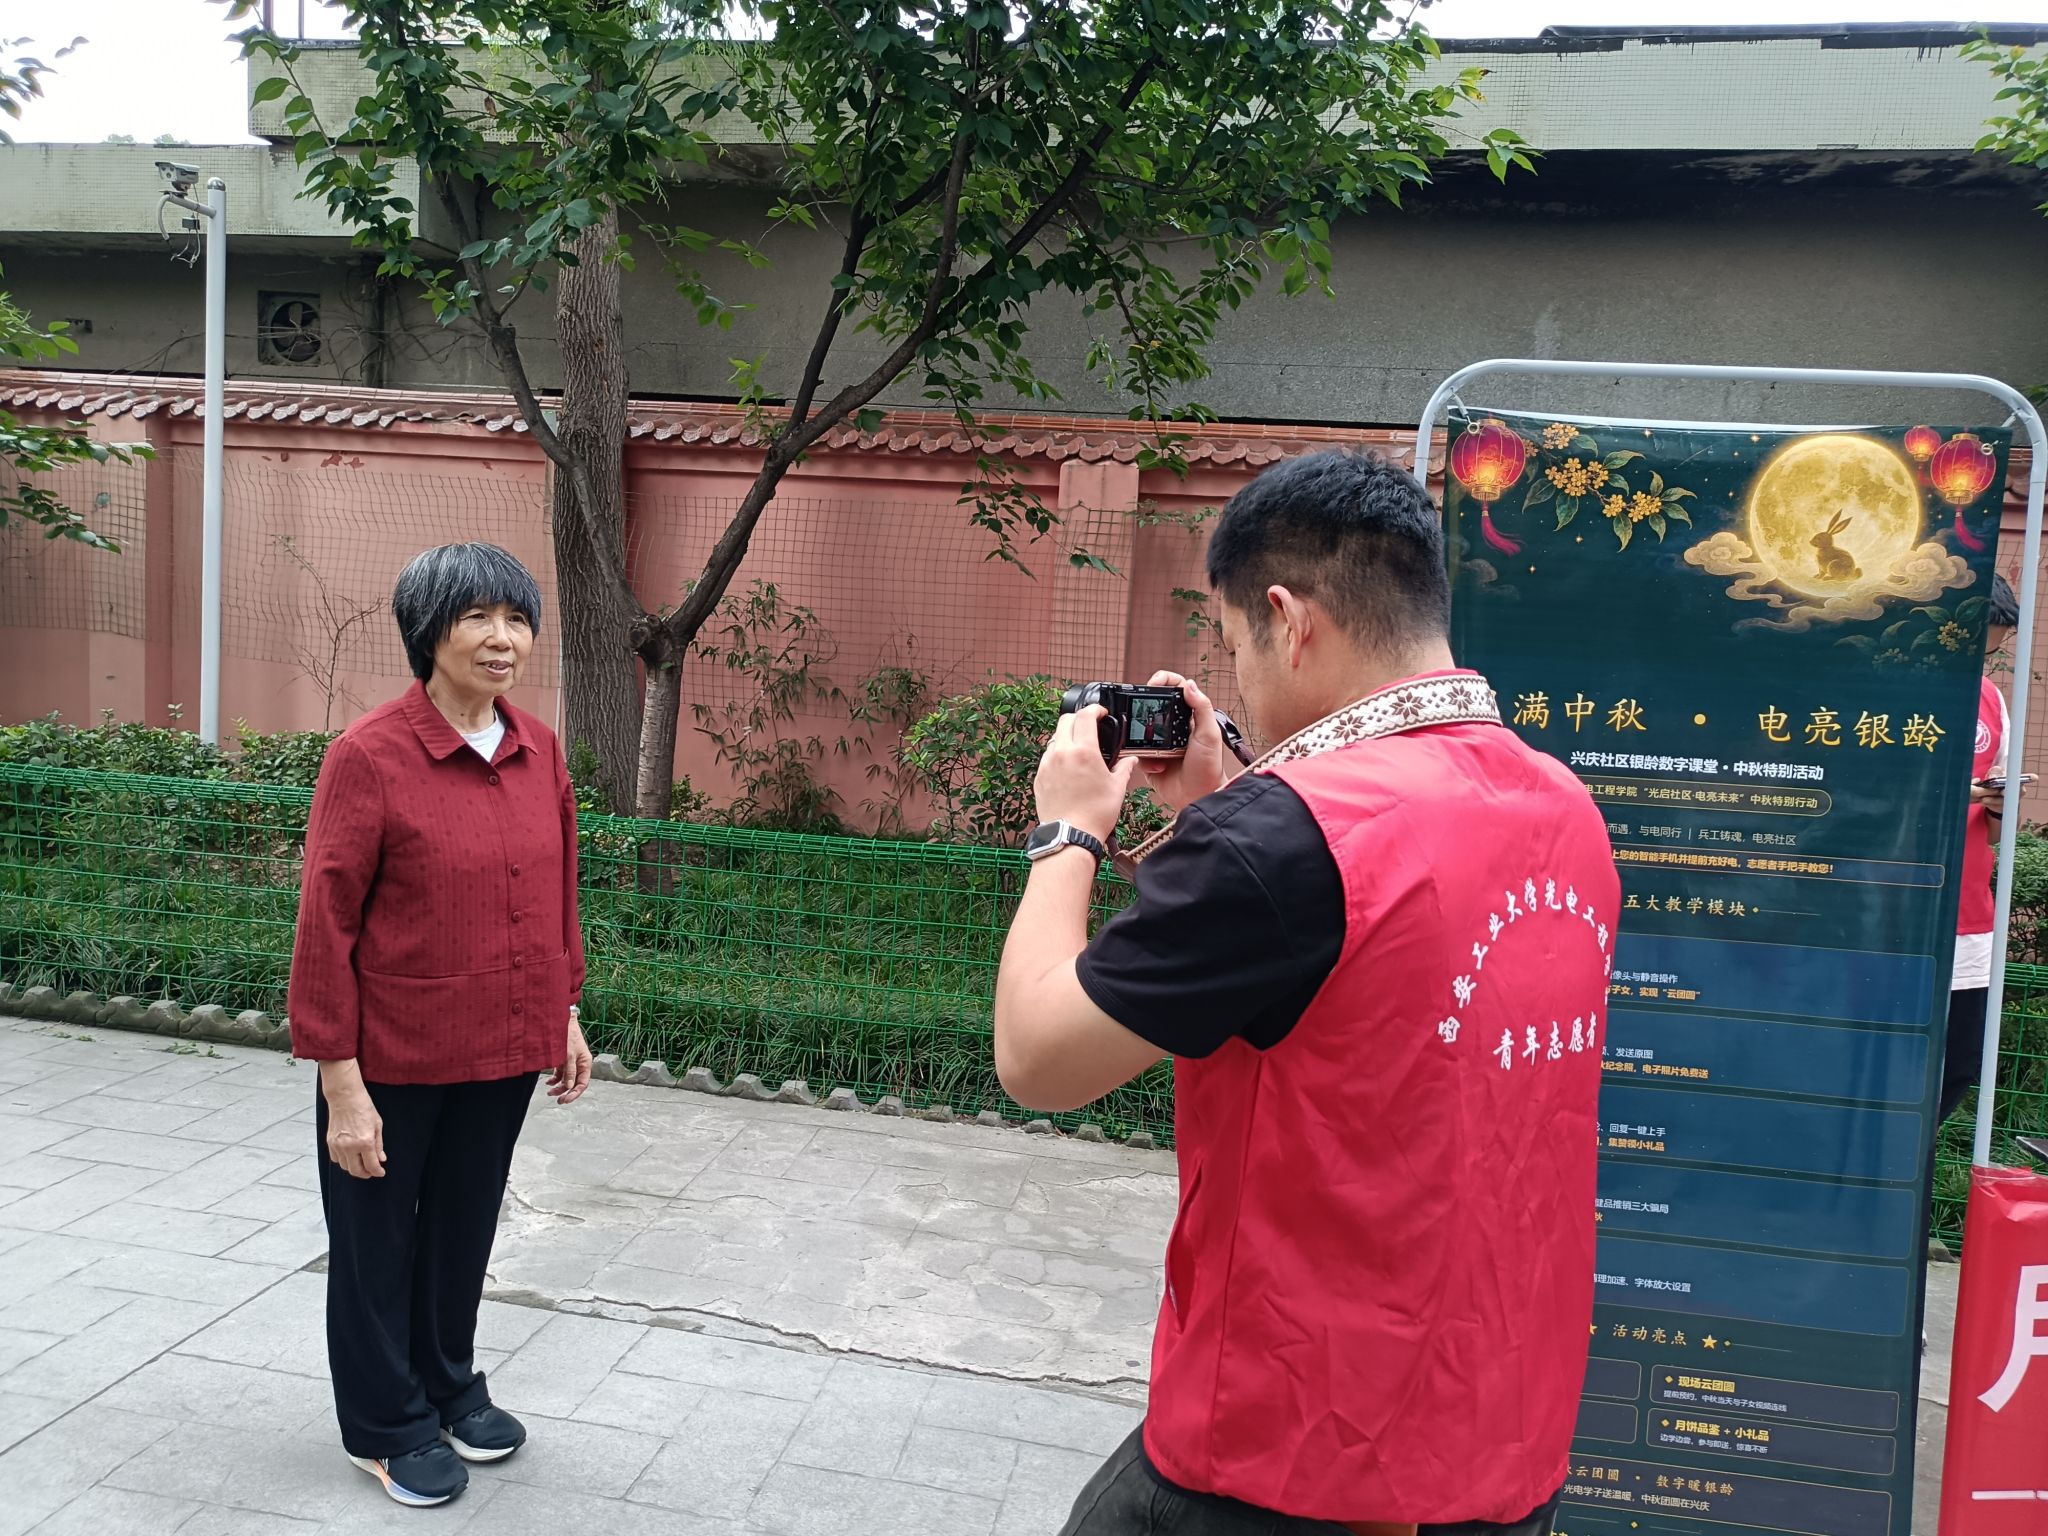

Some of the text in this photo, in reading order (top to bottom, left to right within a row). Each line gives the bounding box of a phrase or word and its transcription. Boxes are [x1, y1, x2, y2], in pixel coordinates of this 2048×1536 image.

[1757, 704, 1946, 753] 电亮银龄
[1623, 894, 1746, 917] 五大教学模块
[1610, 970, 1679, 984] 像头与静音操作
[1612, 1323, 1688, 1346] 活动亮点
